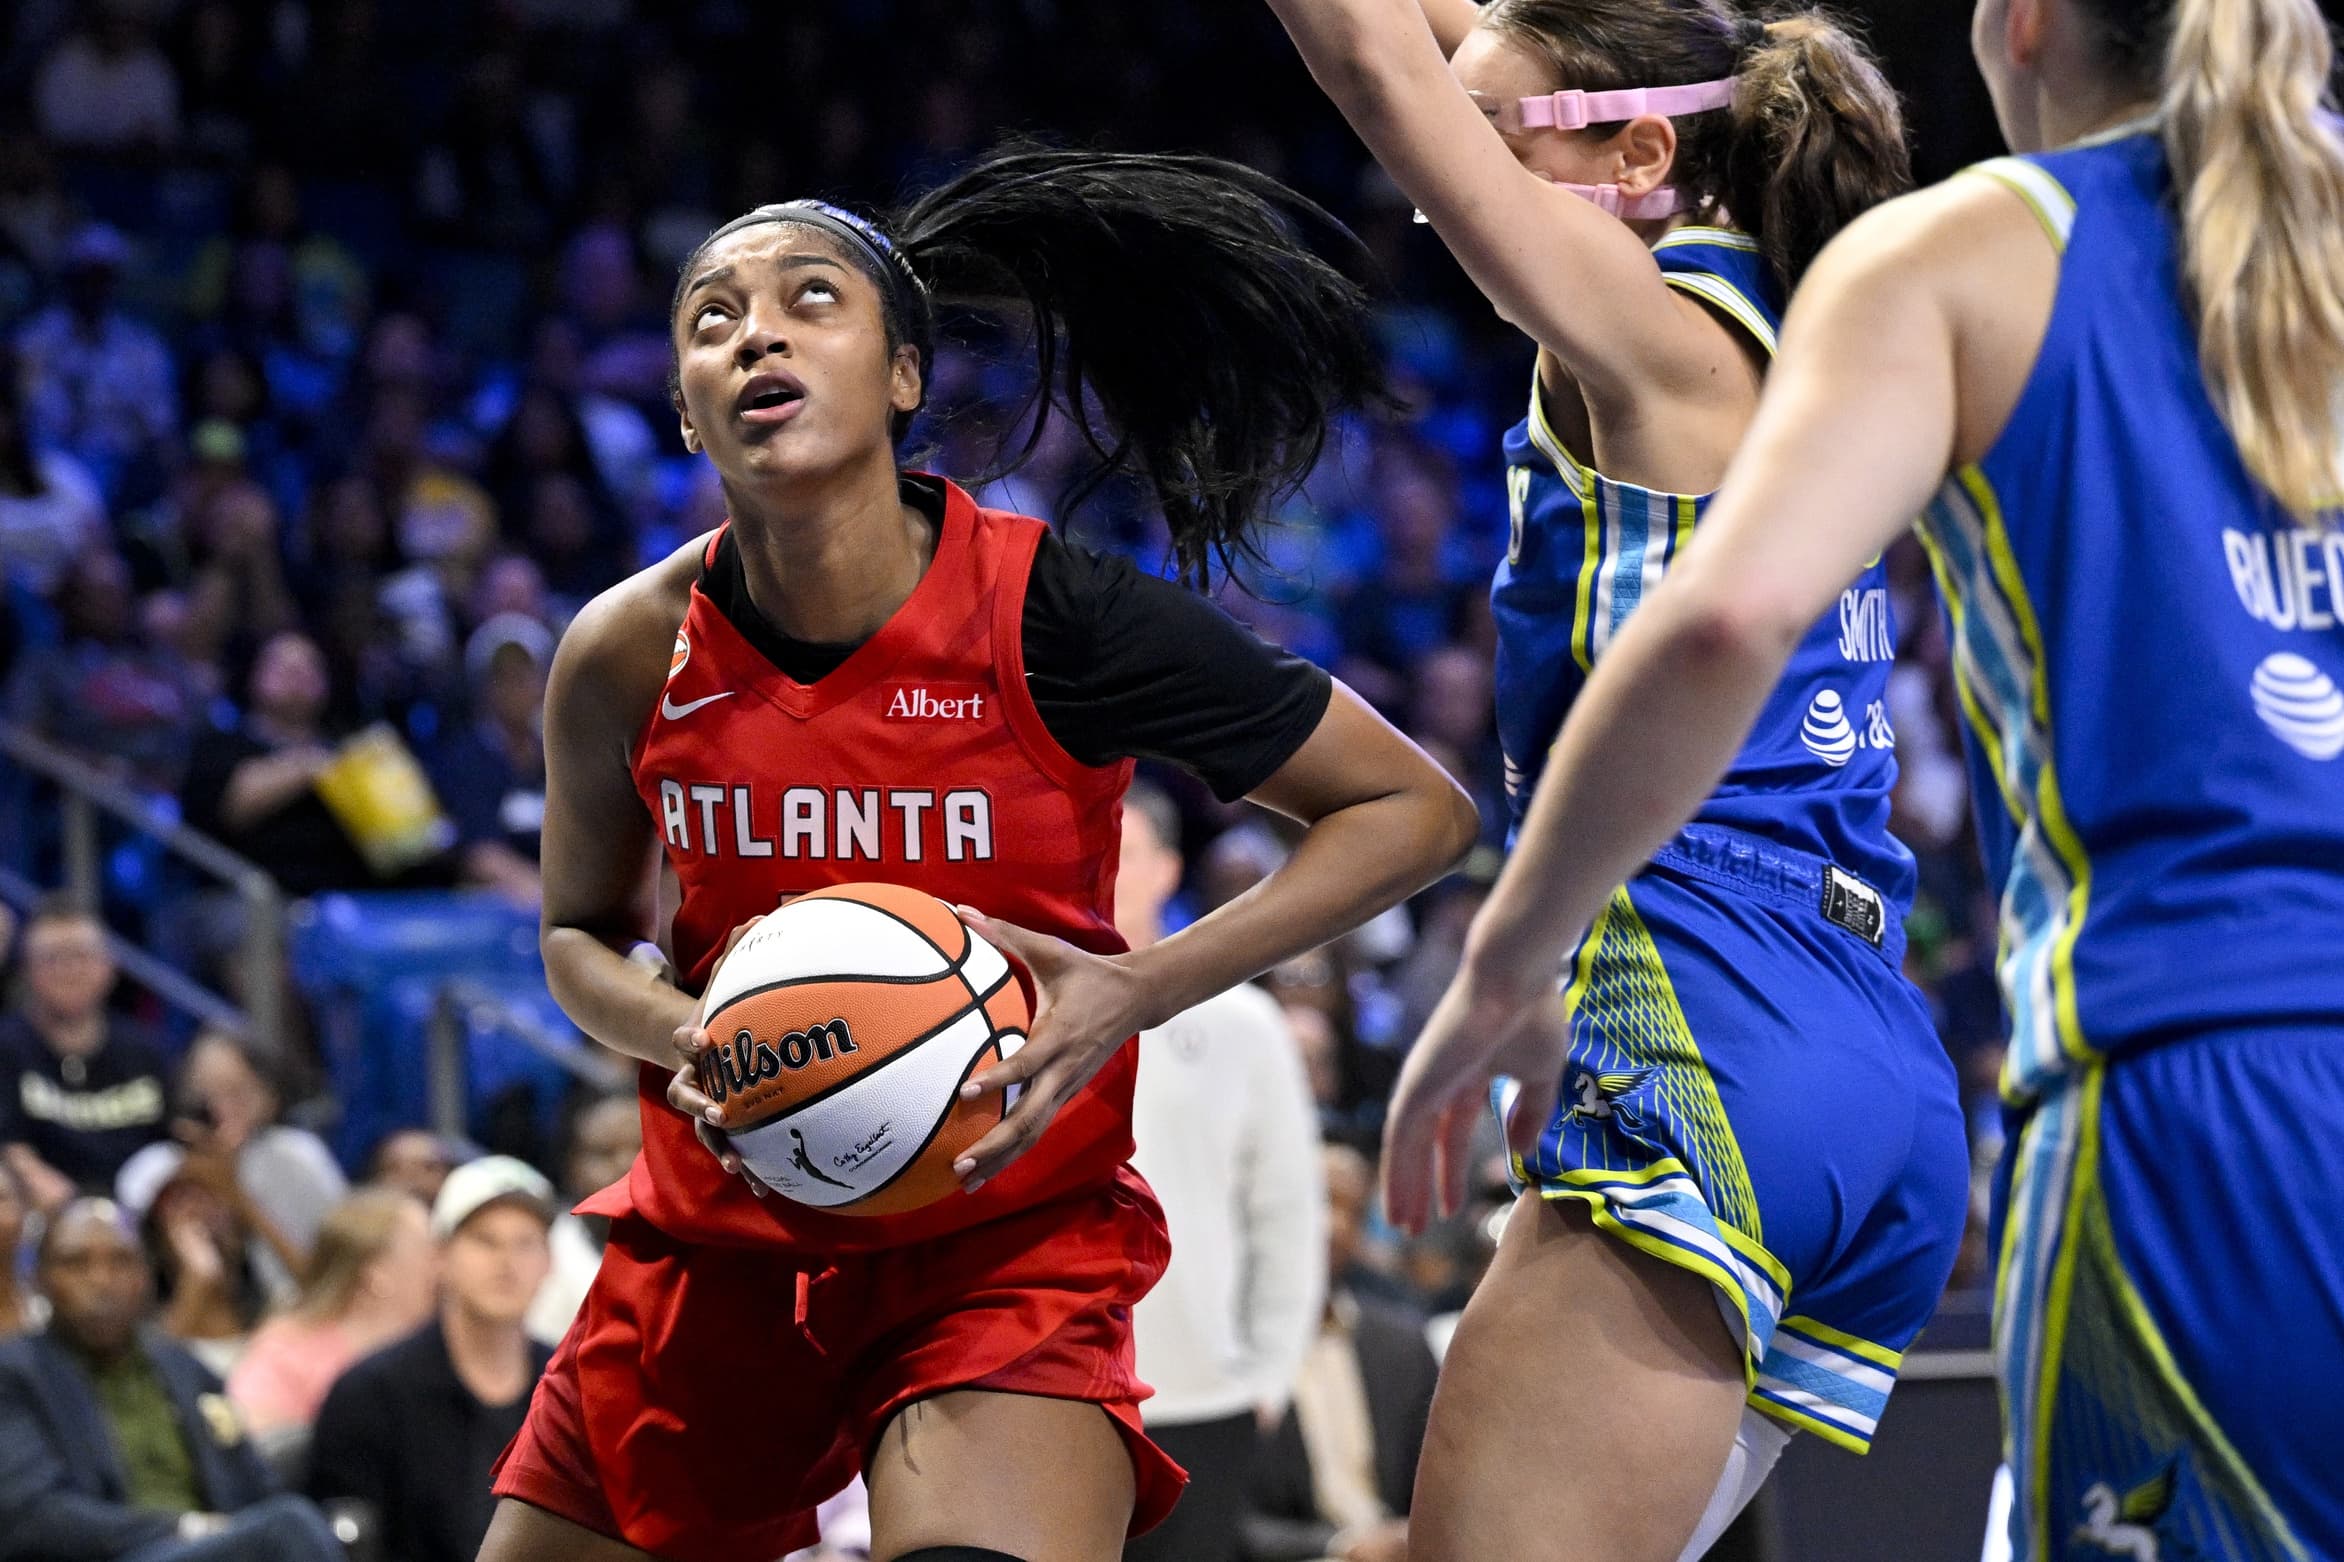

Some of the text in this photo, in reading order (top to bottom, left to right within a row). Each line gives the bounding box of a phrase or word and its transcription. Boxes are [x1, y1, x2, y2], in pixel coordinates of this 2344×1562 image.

[1837, 588, 1896, 662] SMITH
[886, 687, 985, 719] Albert
[659, 777, 993, 863] ATLANTA
[702, 1017, 860, 1104] Wilson
